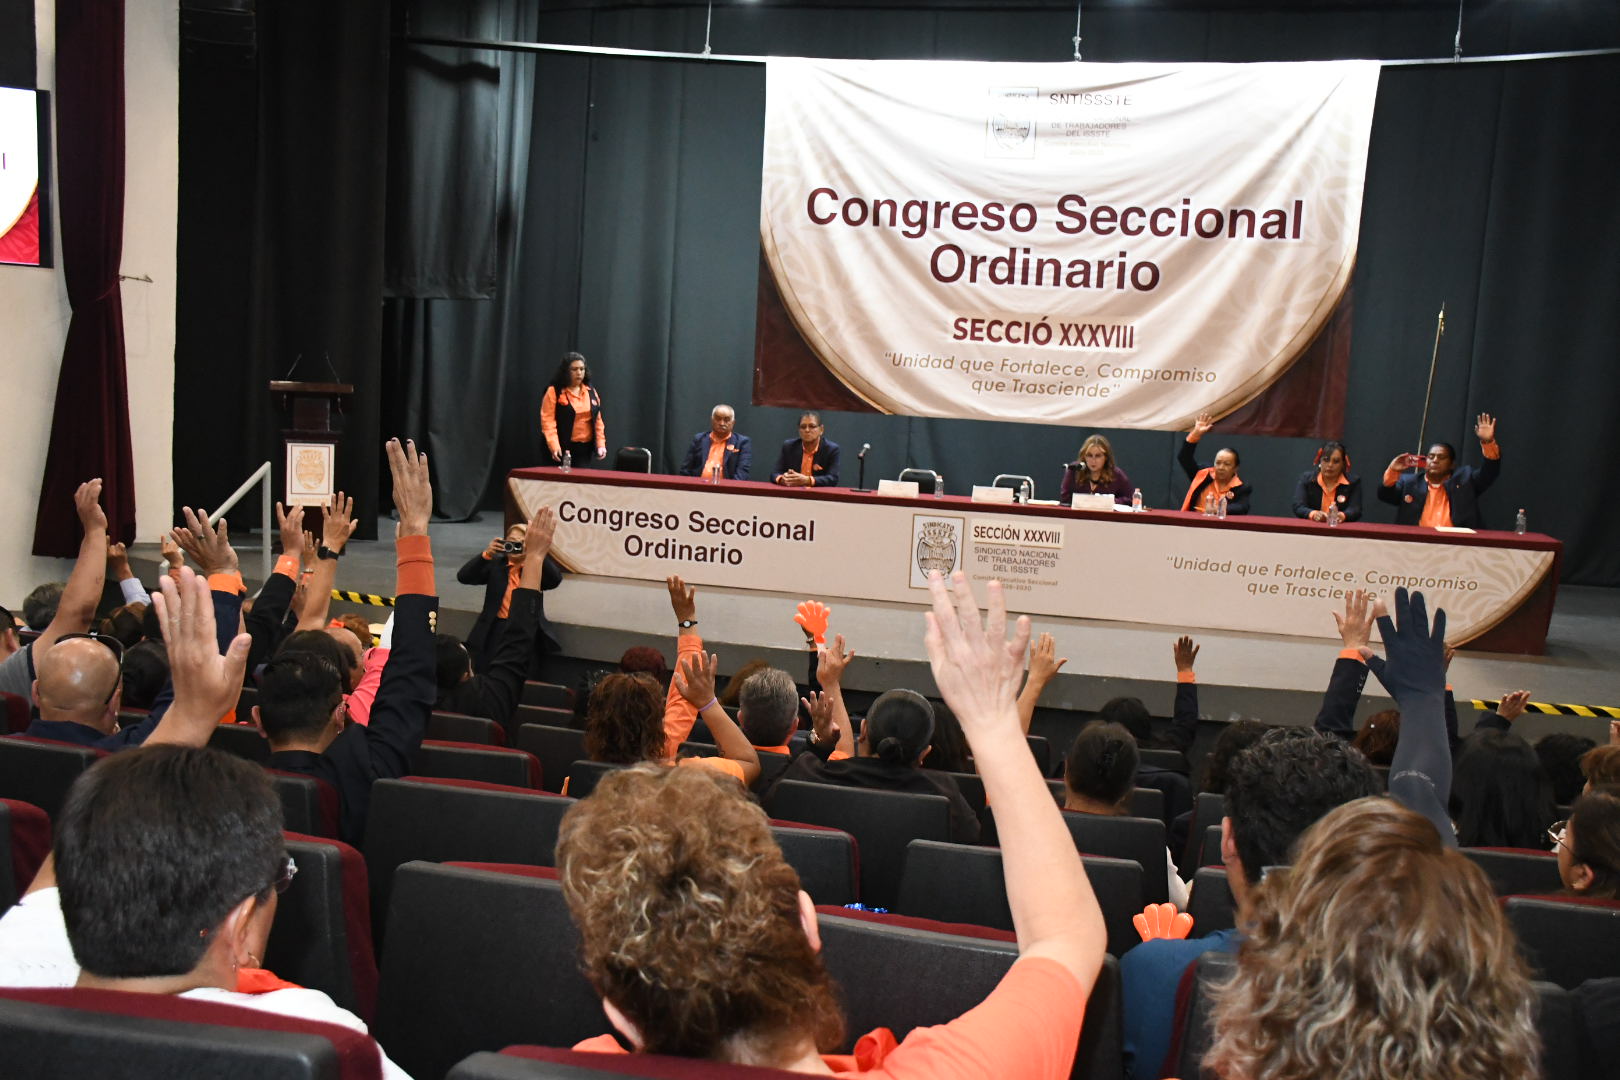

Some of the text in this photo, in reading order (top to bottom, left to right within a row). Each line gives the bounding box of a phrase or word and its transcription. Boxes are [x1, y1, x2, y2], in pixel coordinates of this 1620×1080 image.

[806, 187, 1303, 239] Congreso Seccional
[930, 243, 1160, 292] Ordinario
[953, 316, 1134, 349] SECCIÓ XXXVIII
[960, 359, 994, 375] que
[1097, 363, 1217, 384] Compromiso
[971, 380, 1006, 394] que
[559, 501, 815, 541] Congreso Seccional
[973, 524, 1061, 544] SECCIÓN XXXVIII
[624, 534, 743, 565] Ordinario
[974, 546, 1060, 560] SINDICATO NACIONAL
[977, 554, 1056, 568] DE TRABAJADORES
[993, 564, 1039, 575] DEL ISSSTE
[1236, 563, 1269, 577] que
[1365, 571, 1478, 591] Compromiso
[1247, 582, 1279, 595] que
